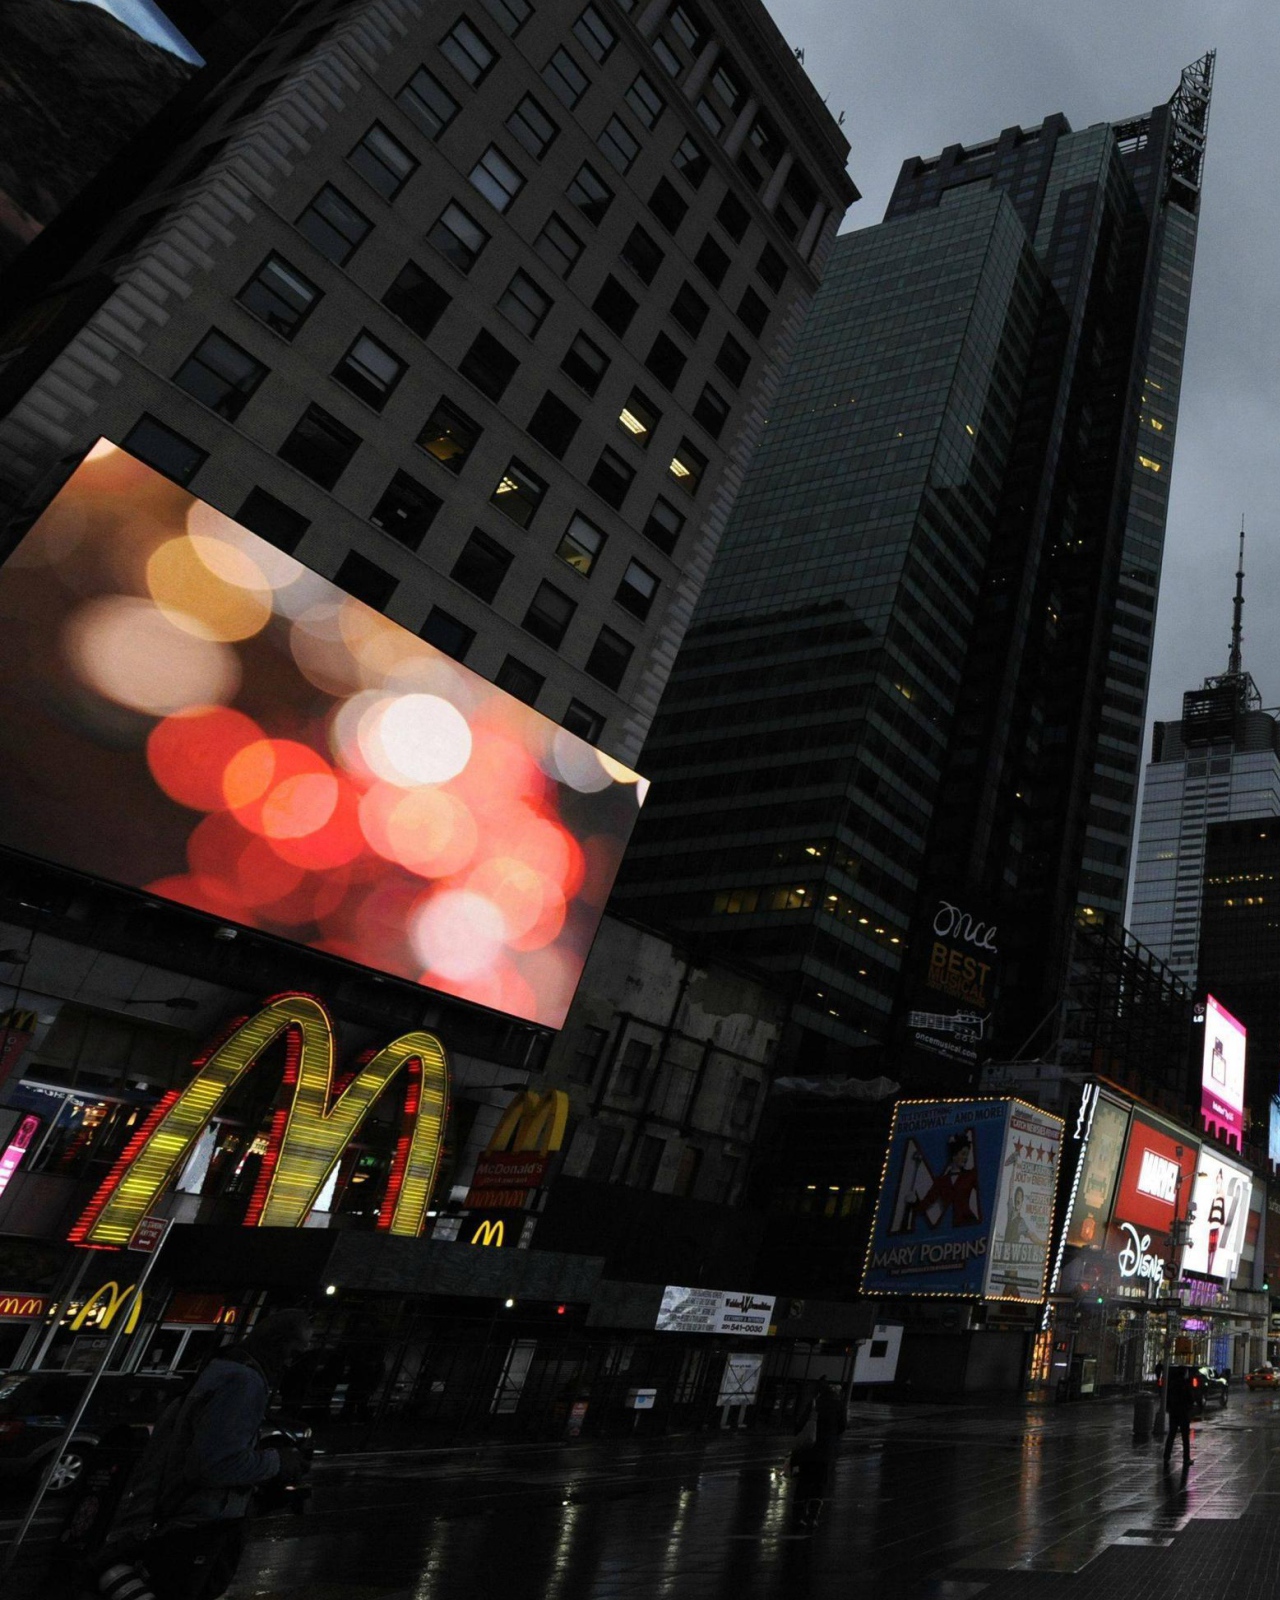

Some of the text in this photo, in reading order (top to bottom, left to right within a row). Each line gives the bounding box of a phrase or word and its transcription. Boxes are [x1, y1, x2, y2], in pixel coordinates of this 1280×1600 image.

[929, 941, 992, 986] BEST
[915, 1031, 978, 1060] oncemusical.com
[476, 1161, 544, 1176] McDonald's
[870, 1246, 917, 1269] MARY
[919, 1236, 988, 1263] POPPINS
[731, 1323, 763, 1333] 541-0030
